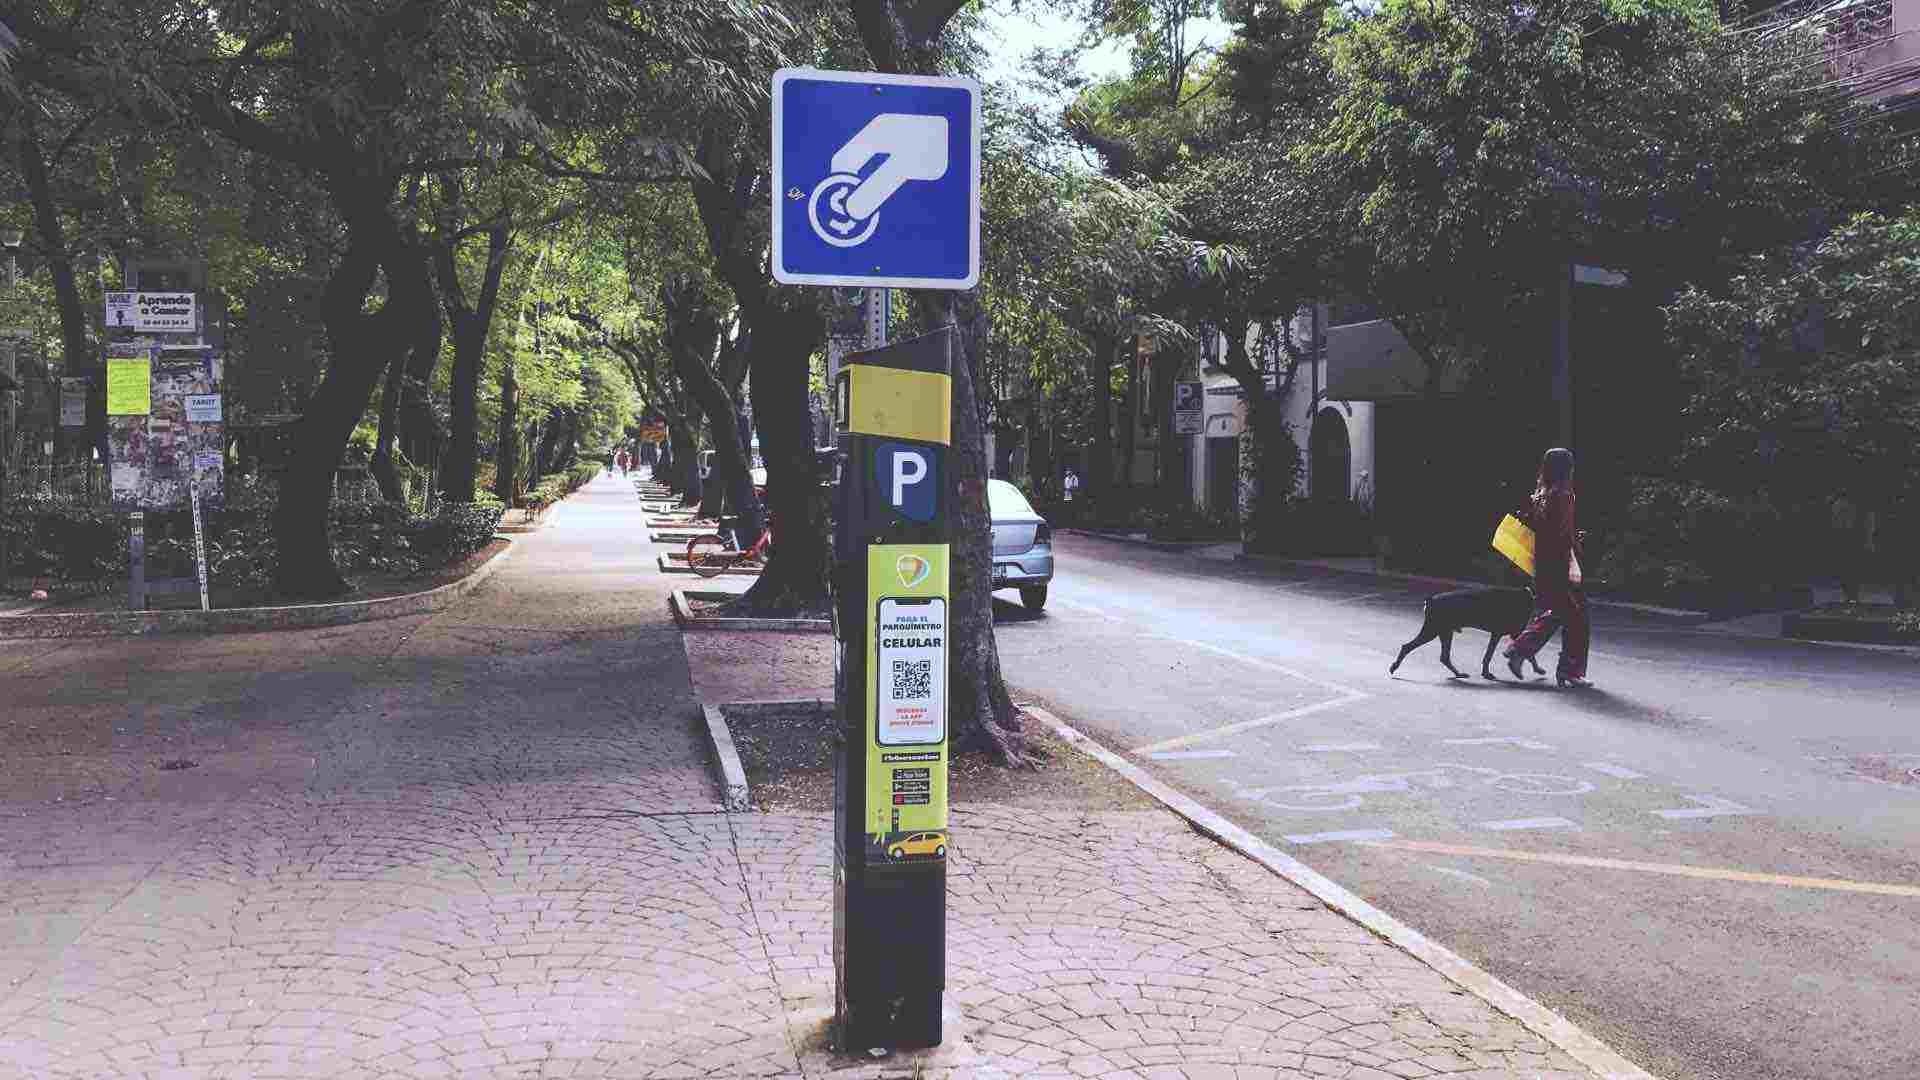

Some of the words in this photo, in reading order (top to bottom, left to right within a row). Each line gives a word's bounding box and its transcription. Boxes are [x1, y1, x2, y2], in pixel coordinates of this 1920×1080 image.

[138, 294, 192, 306] Aprende
[1176, 384, 1193, 407] P
[892, 451, 928, 506] P
[882, 638, 941, 649] CELULAR
